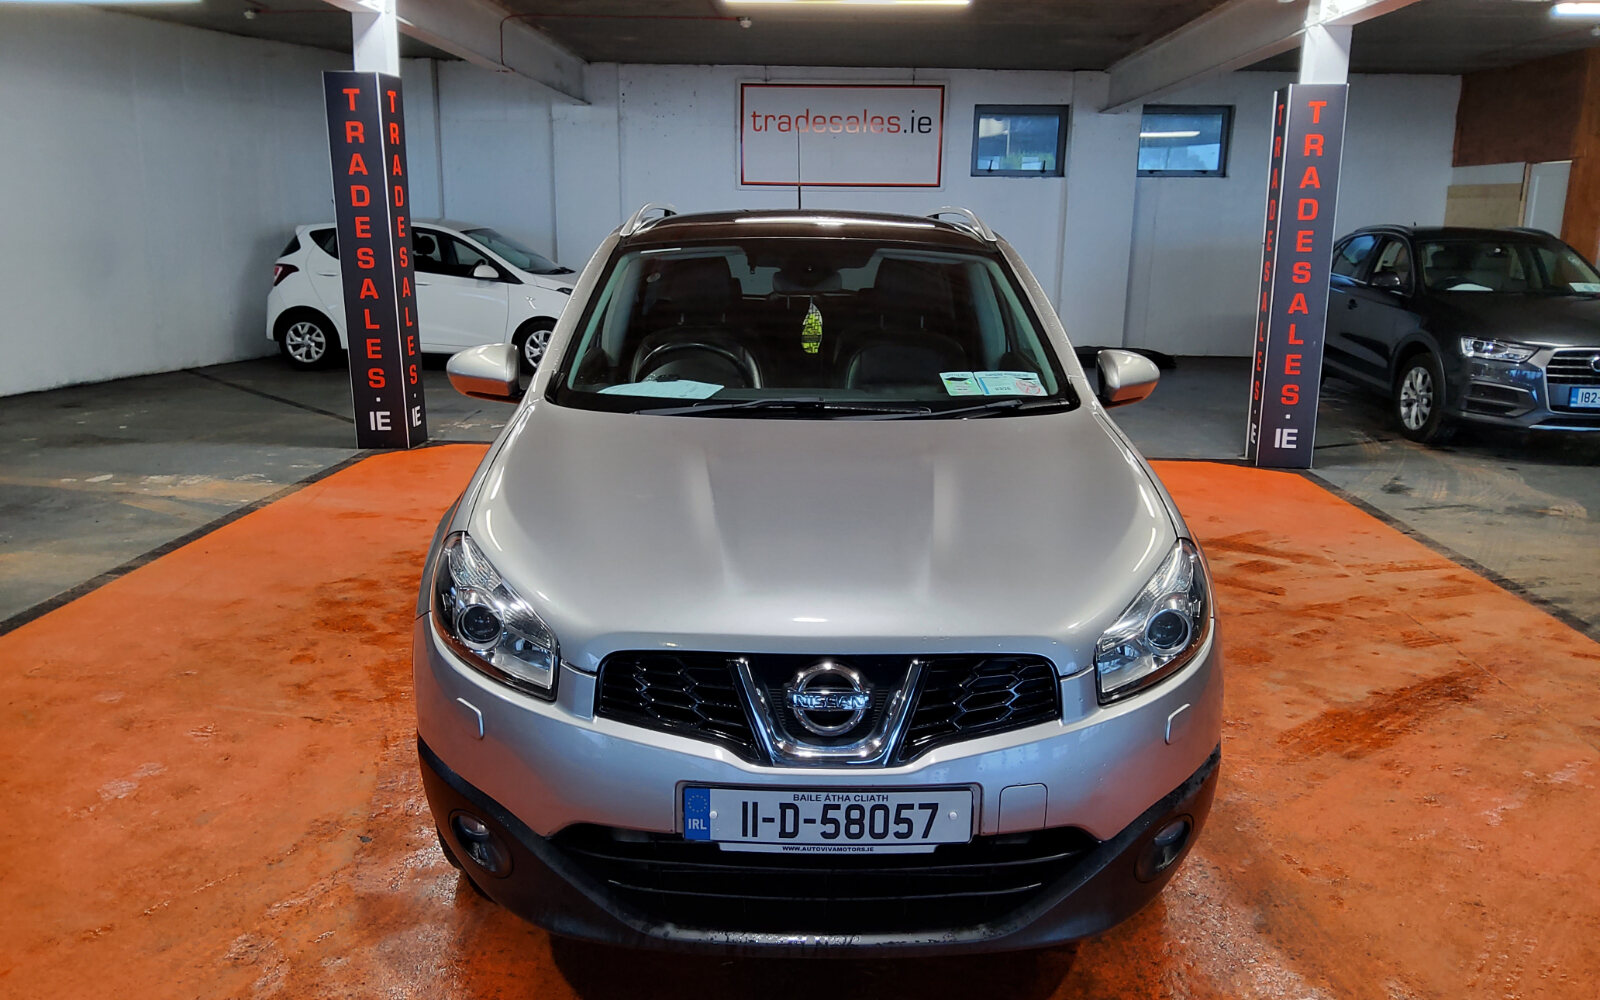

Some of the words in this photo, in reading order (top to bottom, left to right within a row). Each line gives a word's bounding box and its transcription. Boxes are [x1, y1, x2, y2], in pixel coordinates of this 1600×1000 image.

[751, 108, 932, 134] tradesales.ie
[792, 694, 870, 709] NISSAN
[793, 793, 821, 802] BAILE
[824, 793, 850, 802] ÁTHA
[854, 794, 889, 802] CLIATH
[688, 818, 707, 830] IRL
[741, 802, 939, 840] 11-D-58057
